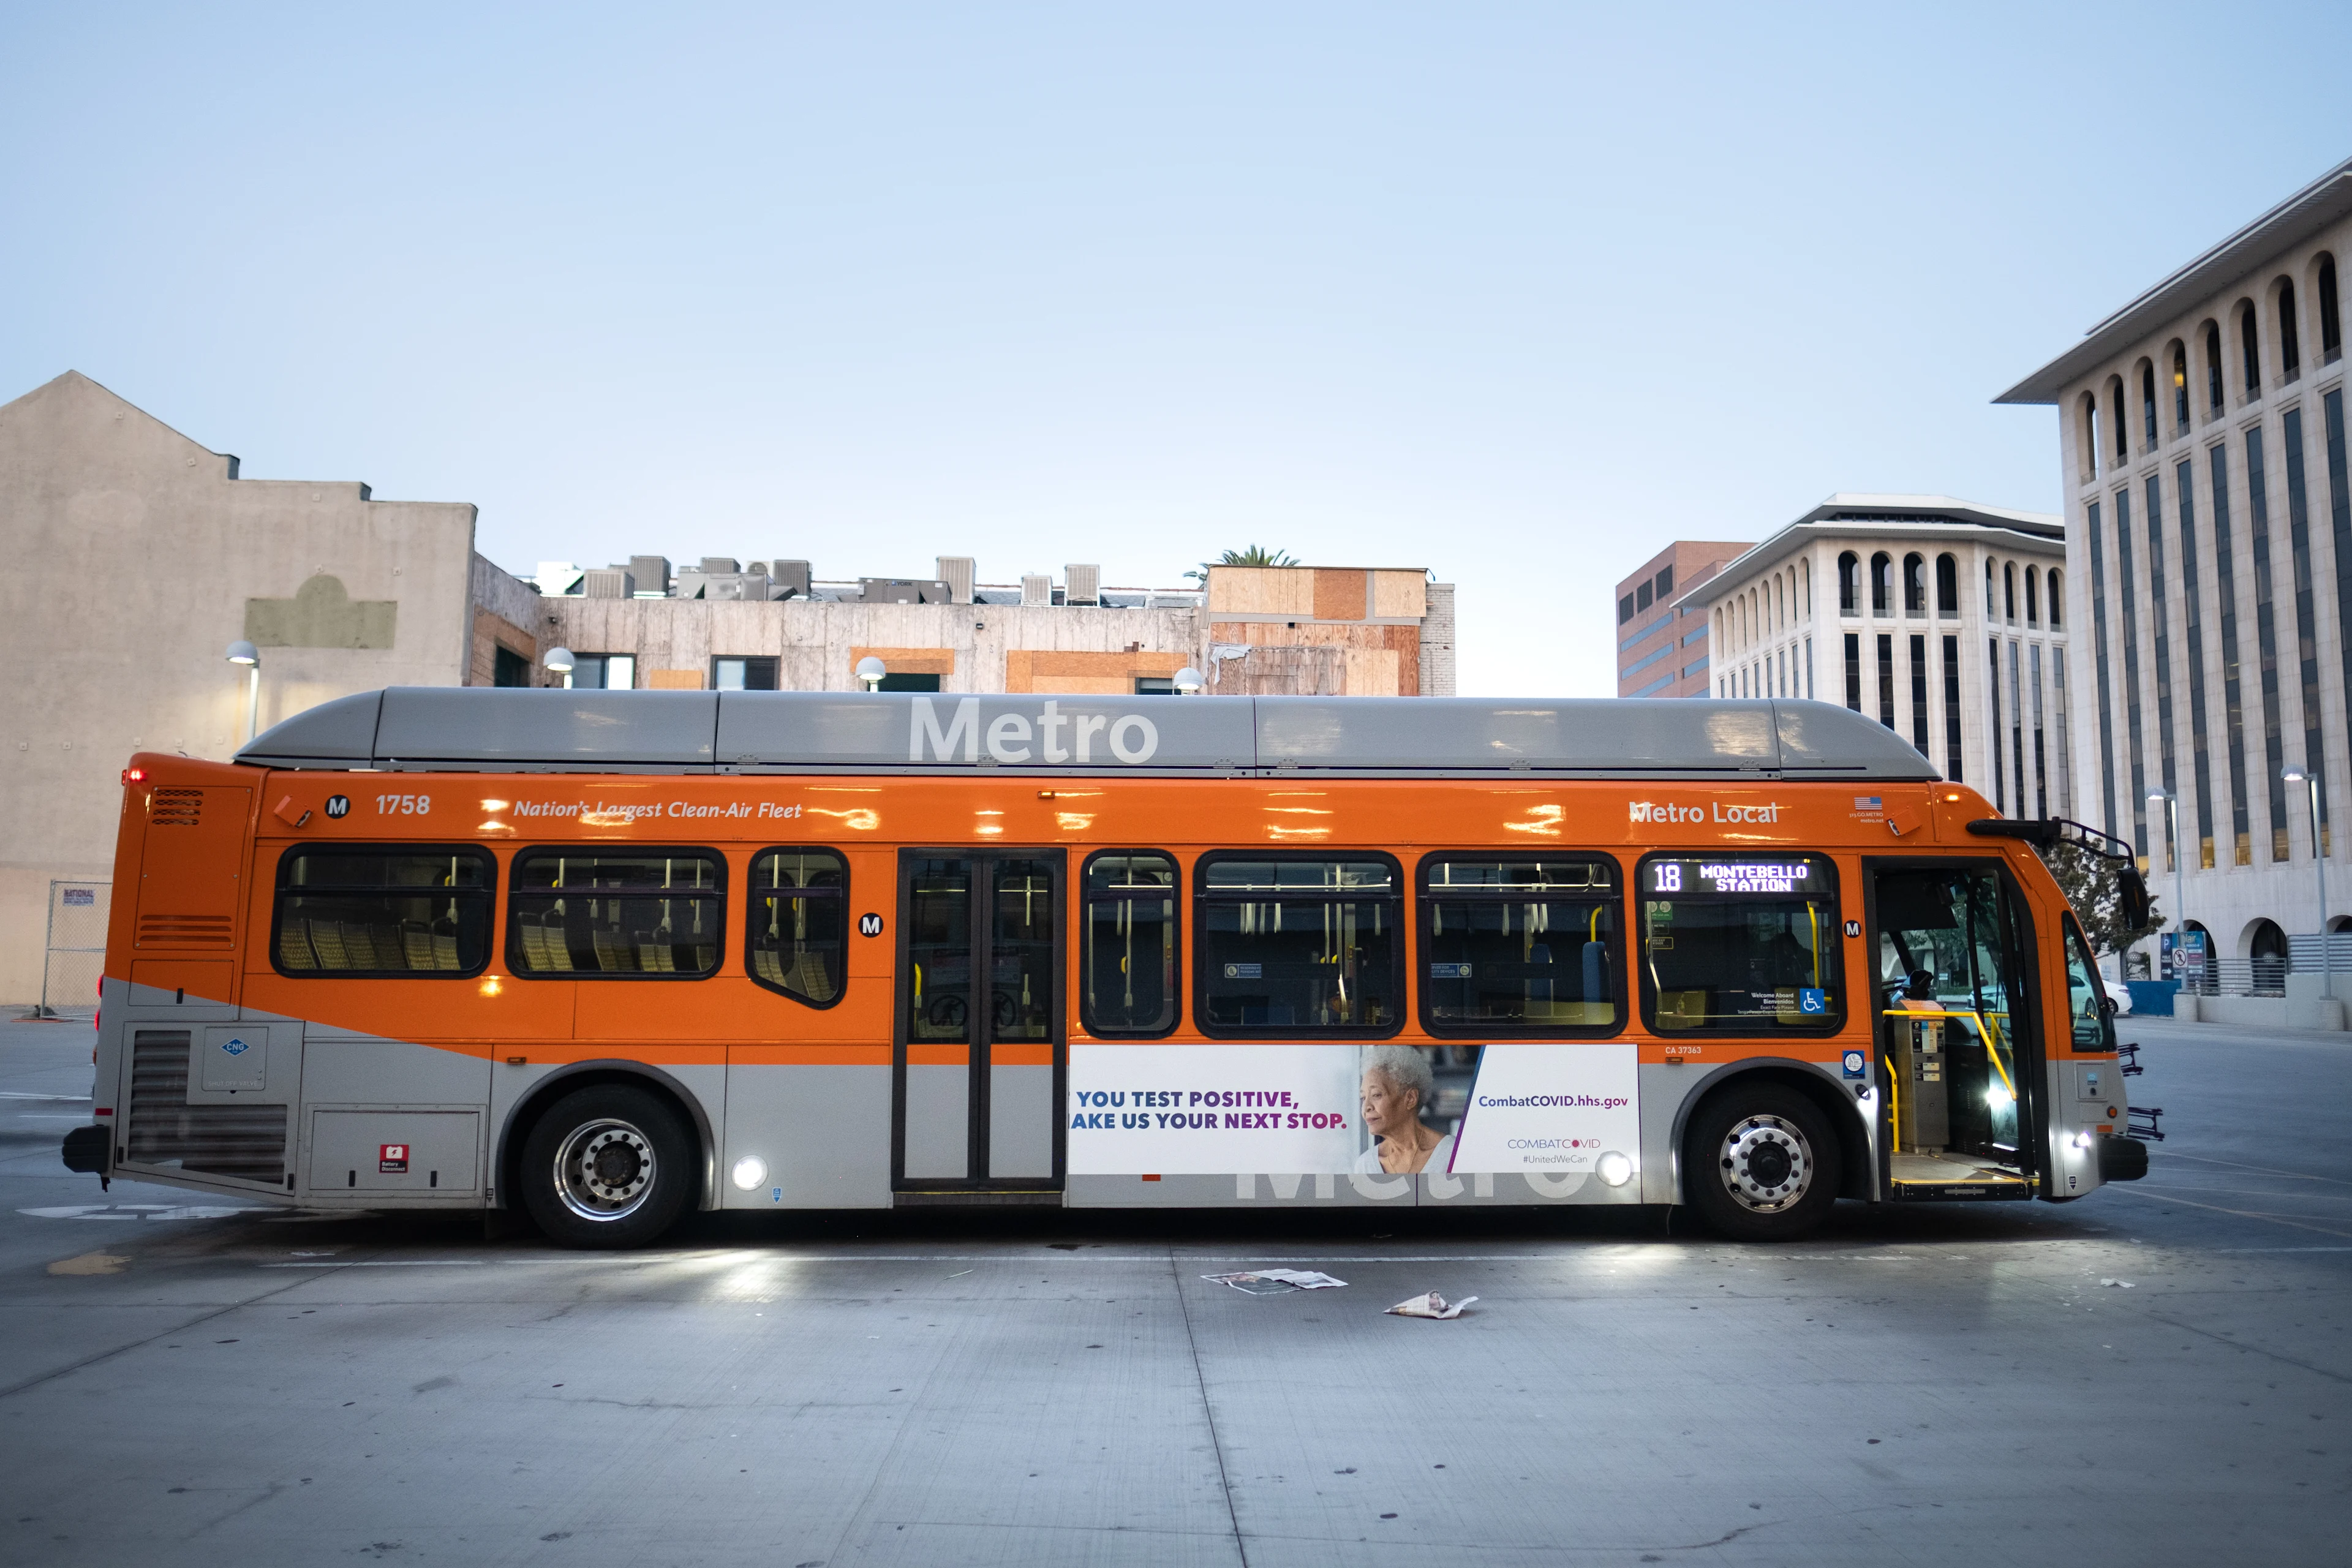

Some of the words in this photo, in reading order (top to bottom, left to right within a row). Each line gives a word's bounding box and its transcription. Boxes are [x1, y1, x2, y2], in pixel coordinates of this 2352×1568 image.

[910, 696, 1159, 764] Metro
[328, 798, 347, 814] M
[376, 794, 430, 815] 1758
[595, 801, 663, 821] Largest
[668, 801, 752, 818] Clean-Air
[758, 803, 802, 818] Fleet
[1629, 801, 1705, 823] Metro
[1713, 802, 1777, 823] Local
[1654, 865, 1681, 891] 18
[1700, 865, 1807, 878] MONTEBELLO
[1716, 878, 1792, 891] STATION
[862, 916, 880, 933] M
[1846, 922, 1859, 935] M
[1076, 1091, 1125, 1107] YOU
[1132, 1091, 1183, 1107] TEST
[1189, 1091, 1298, 1110] POSITIVE,
[1479, 1095, 1628, 1109] CombatCOVID.hhs.gov
[1068, 1113, 1115, 1129] AKE
[1122, 1113, 1150, 1129] US
[1155, 1113, 1218, 1129] YOUR
[1225, 1113, 1281, 1129] NEXT
[1287, 1113, 1347, 1129] STOP.
